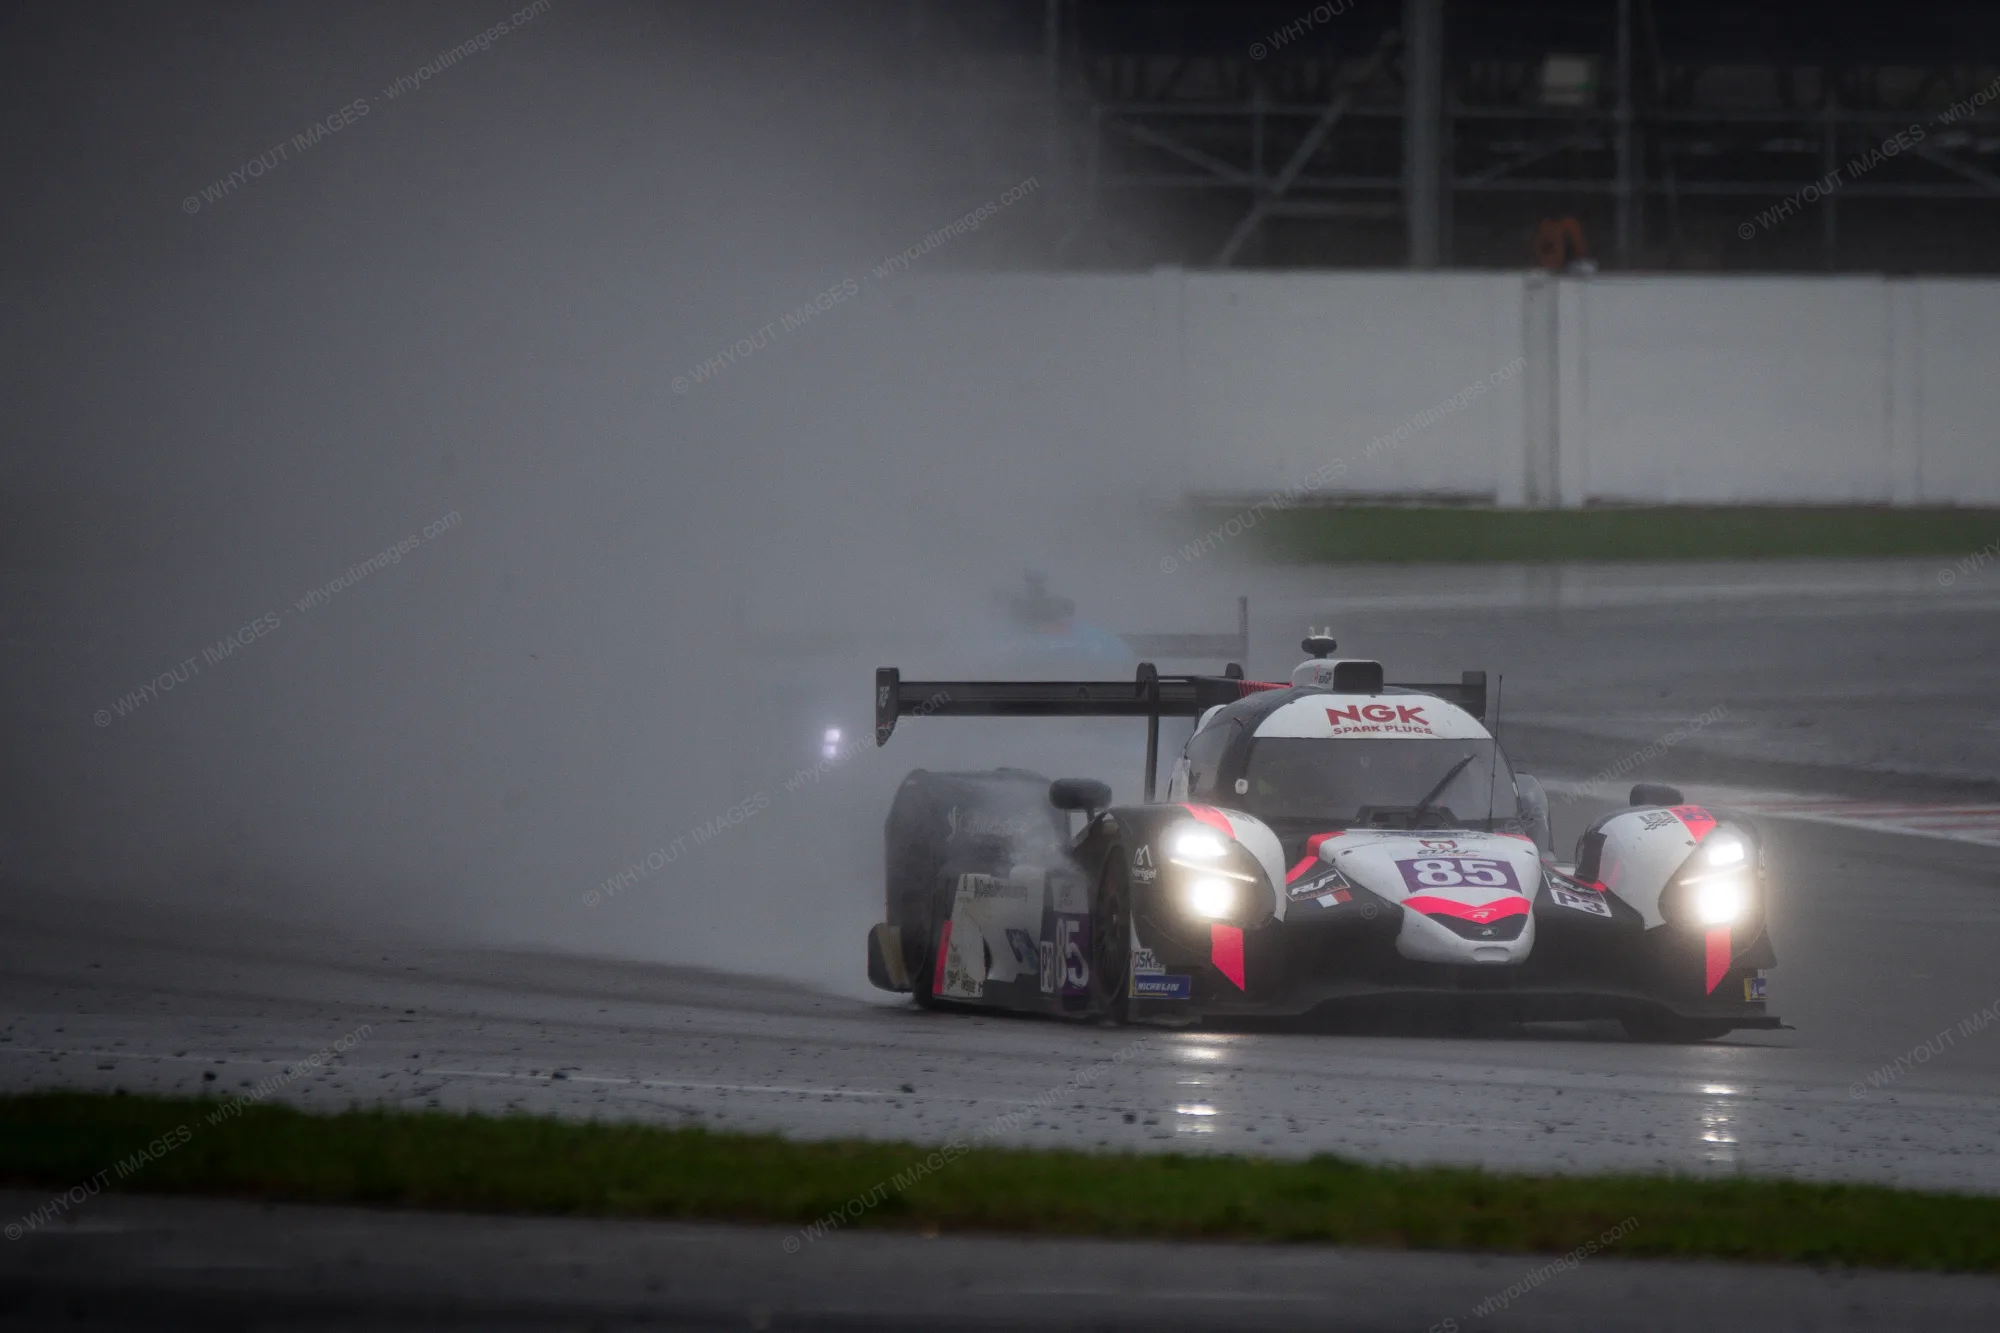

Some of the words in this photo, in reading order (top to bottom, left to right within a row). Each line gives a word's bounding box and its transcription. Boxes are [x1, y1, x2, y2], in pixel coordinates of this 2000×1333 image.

[1325, 704, 1430, 726] NGK
[1333, 726, 1381, 735] SPARK
[1385, 725, 1433, 735] PLUGS
[1413, 859, 1507, 886] 85
[1556, 891, 1606, 914] P3
[1055, 918, 1090, 990] 85
[1137, 983, 1180, 992] MICHELIN
